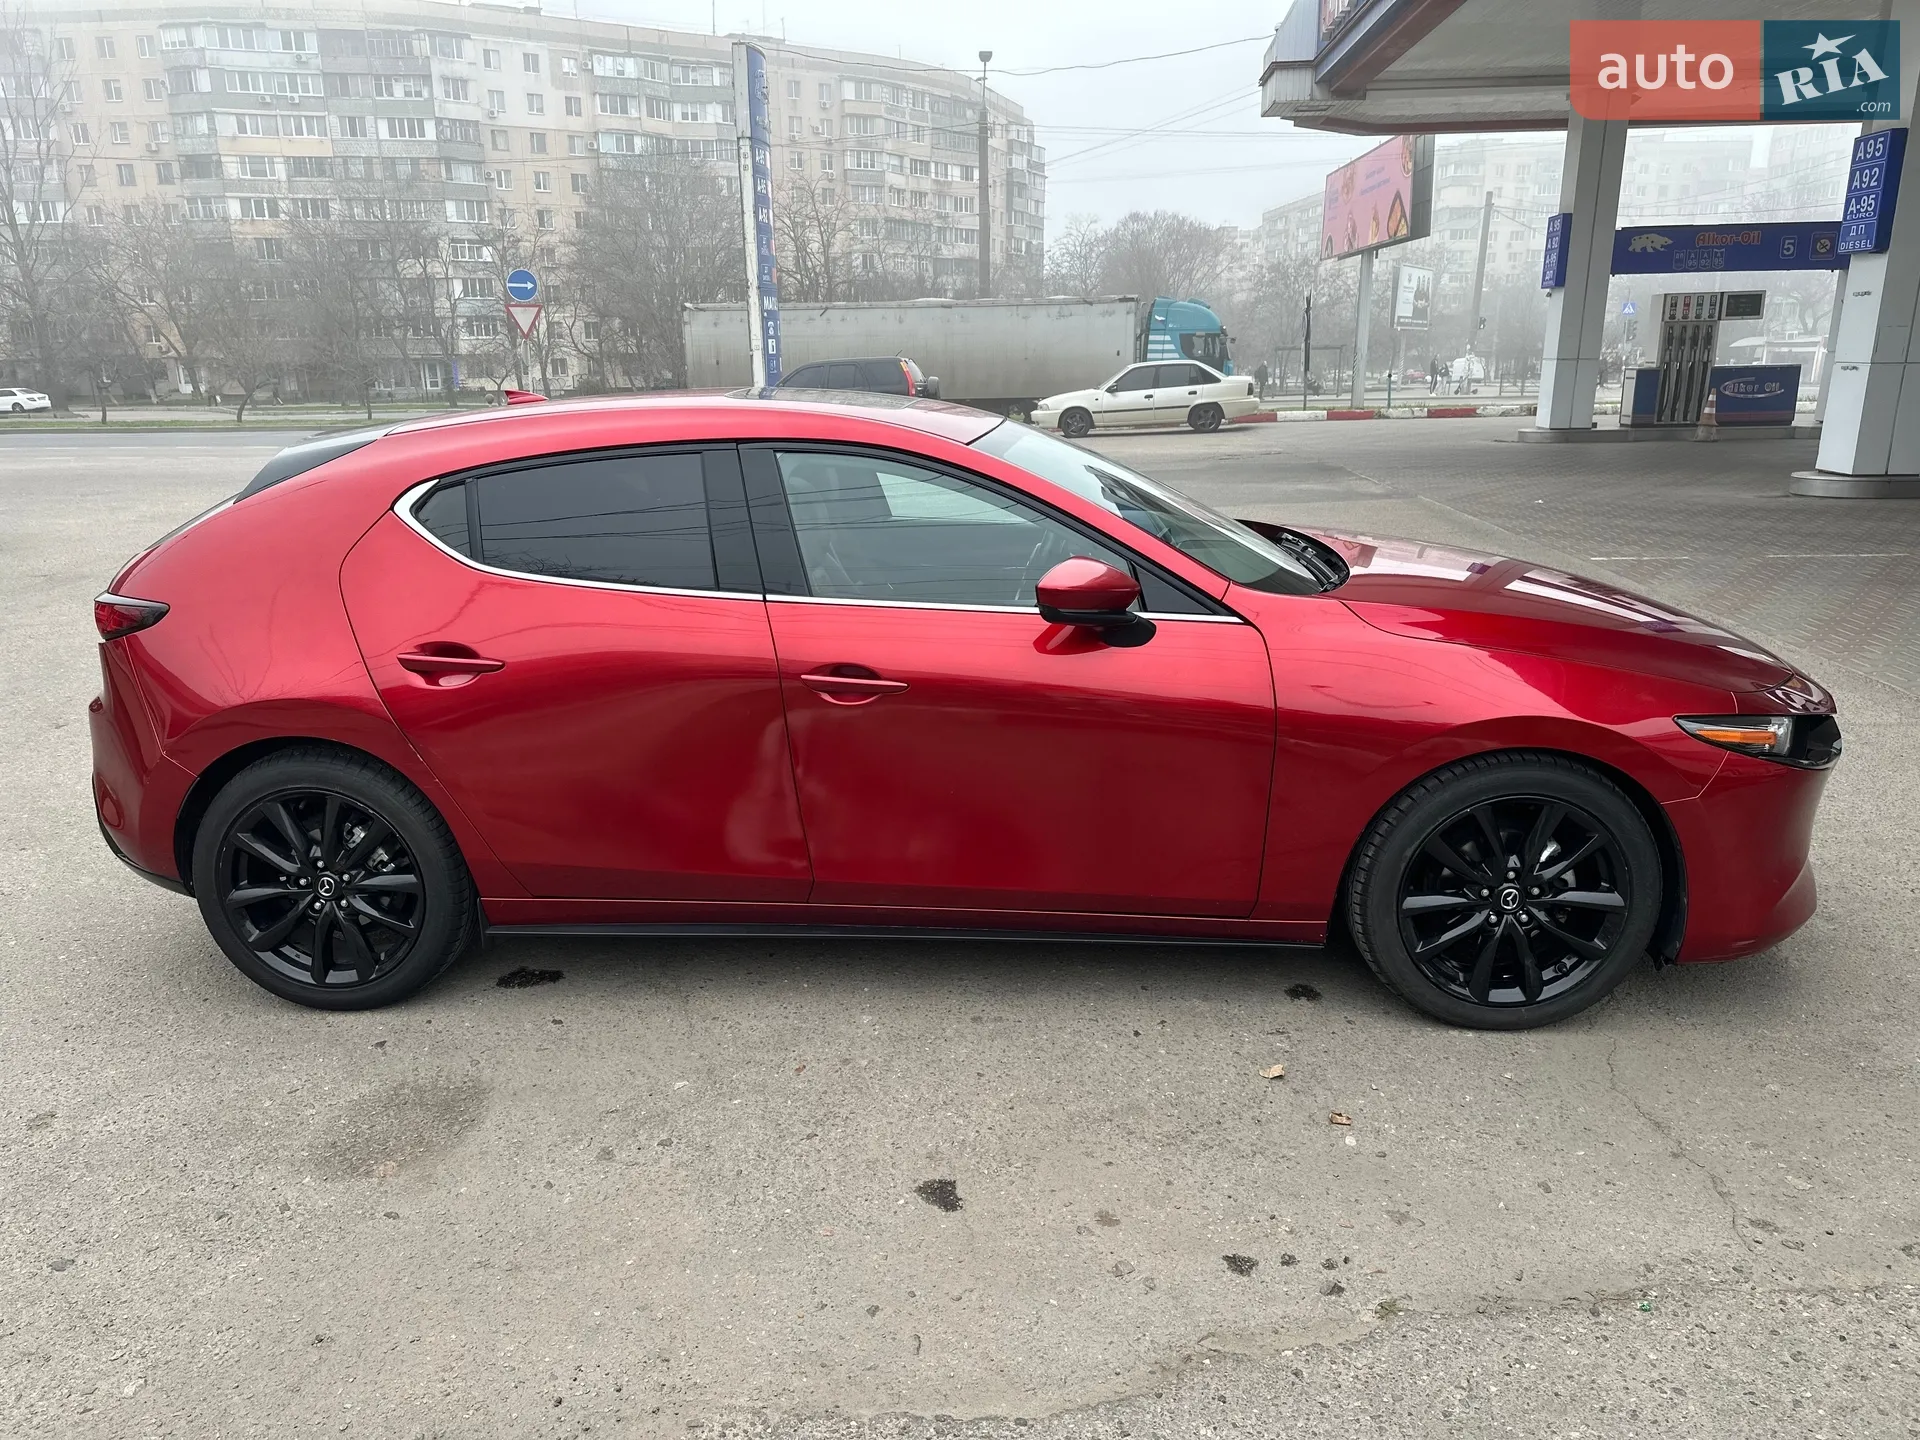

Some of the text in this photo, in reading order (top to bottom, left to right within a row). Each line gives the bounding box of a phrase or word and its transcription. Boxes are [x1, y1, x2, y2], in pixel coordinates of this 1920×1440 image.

[1847, 194, 1876, 214] A-95
[1846, 211, 1874, 220] EURO
[1695, 231, 1762, 248] Alkor-Oil
[1783, 239, 1795, 255] 5
[1840, 239, 1872, 251] DIESEL
